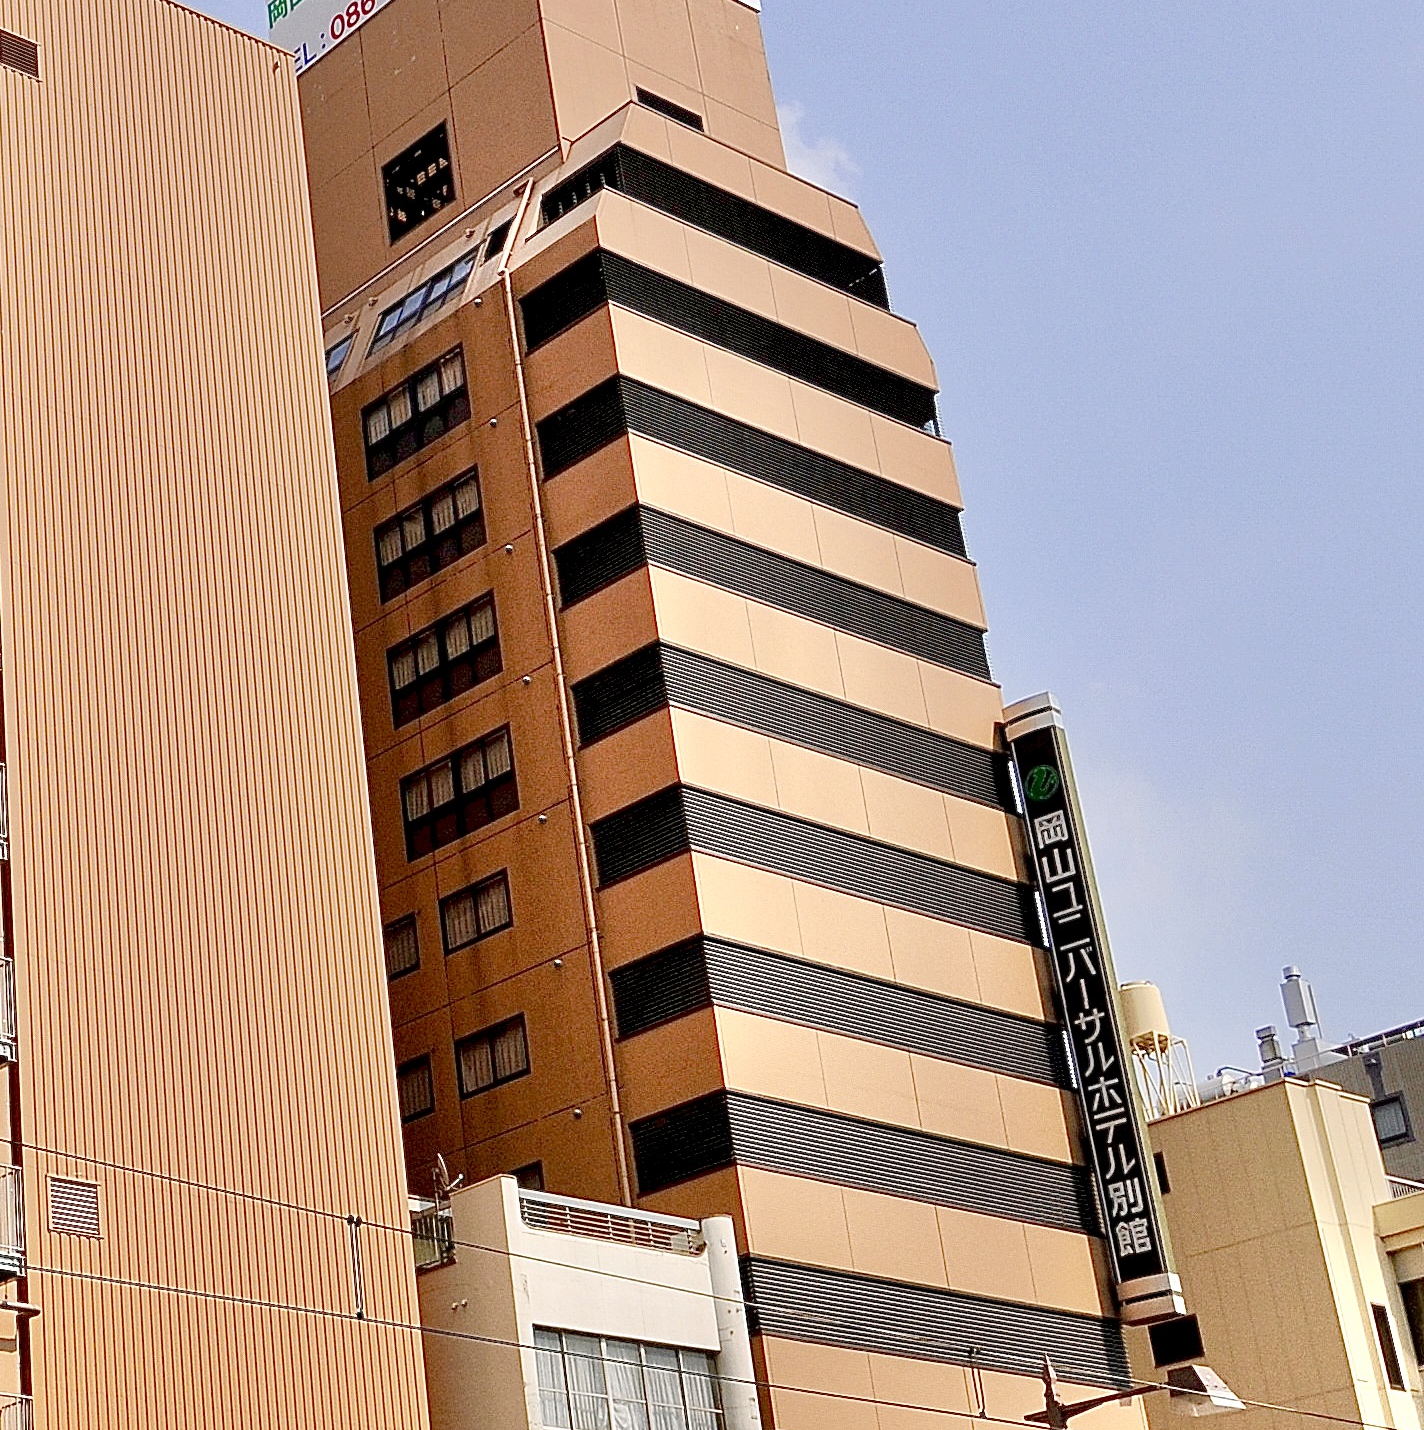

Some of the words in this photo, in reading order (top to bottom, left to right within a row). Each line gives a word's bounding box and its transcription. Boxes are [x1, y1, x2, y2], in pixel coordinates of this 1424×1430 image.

[1034, 810, 1154, 1256] 岡山ユニバーサルホテル別館
